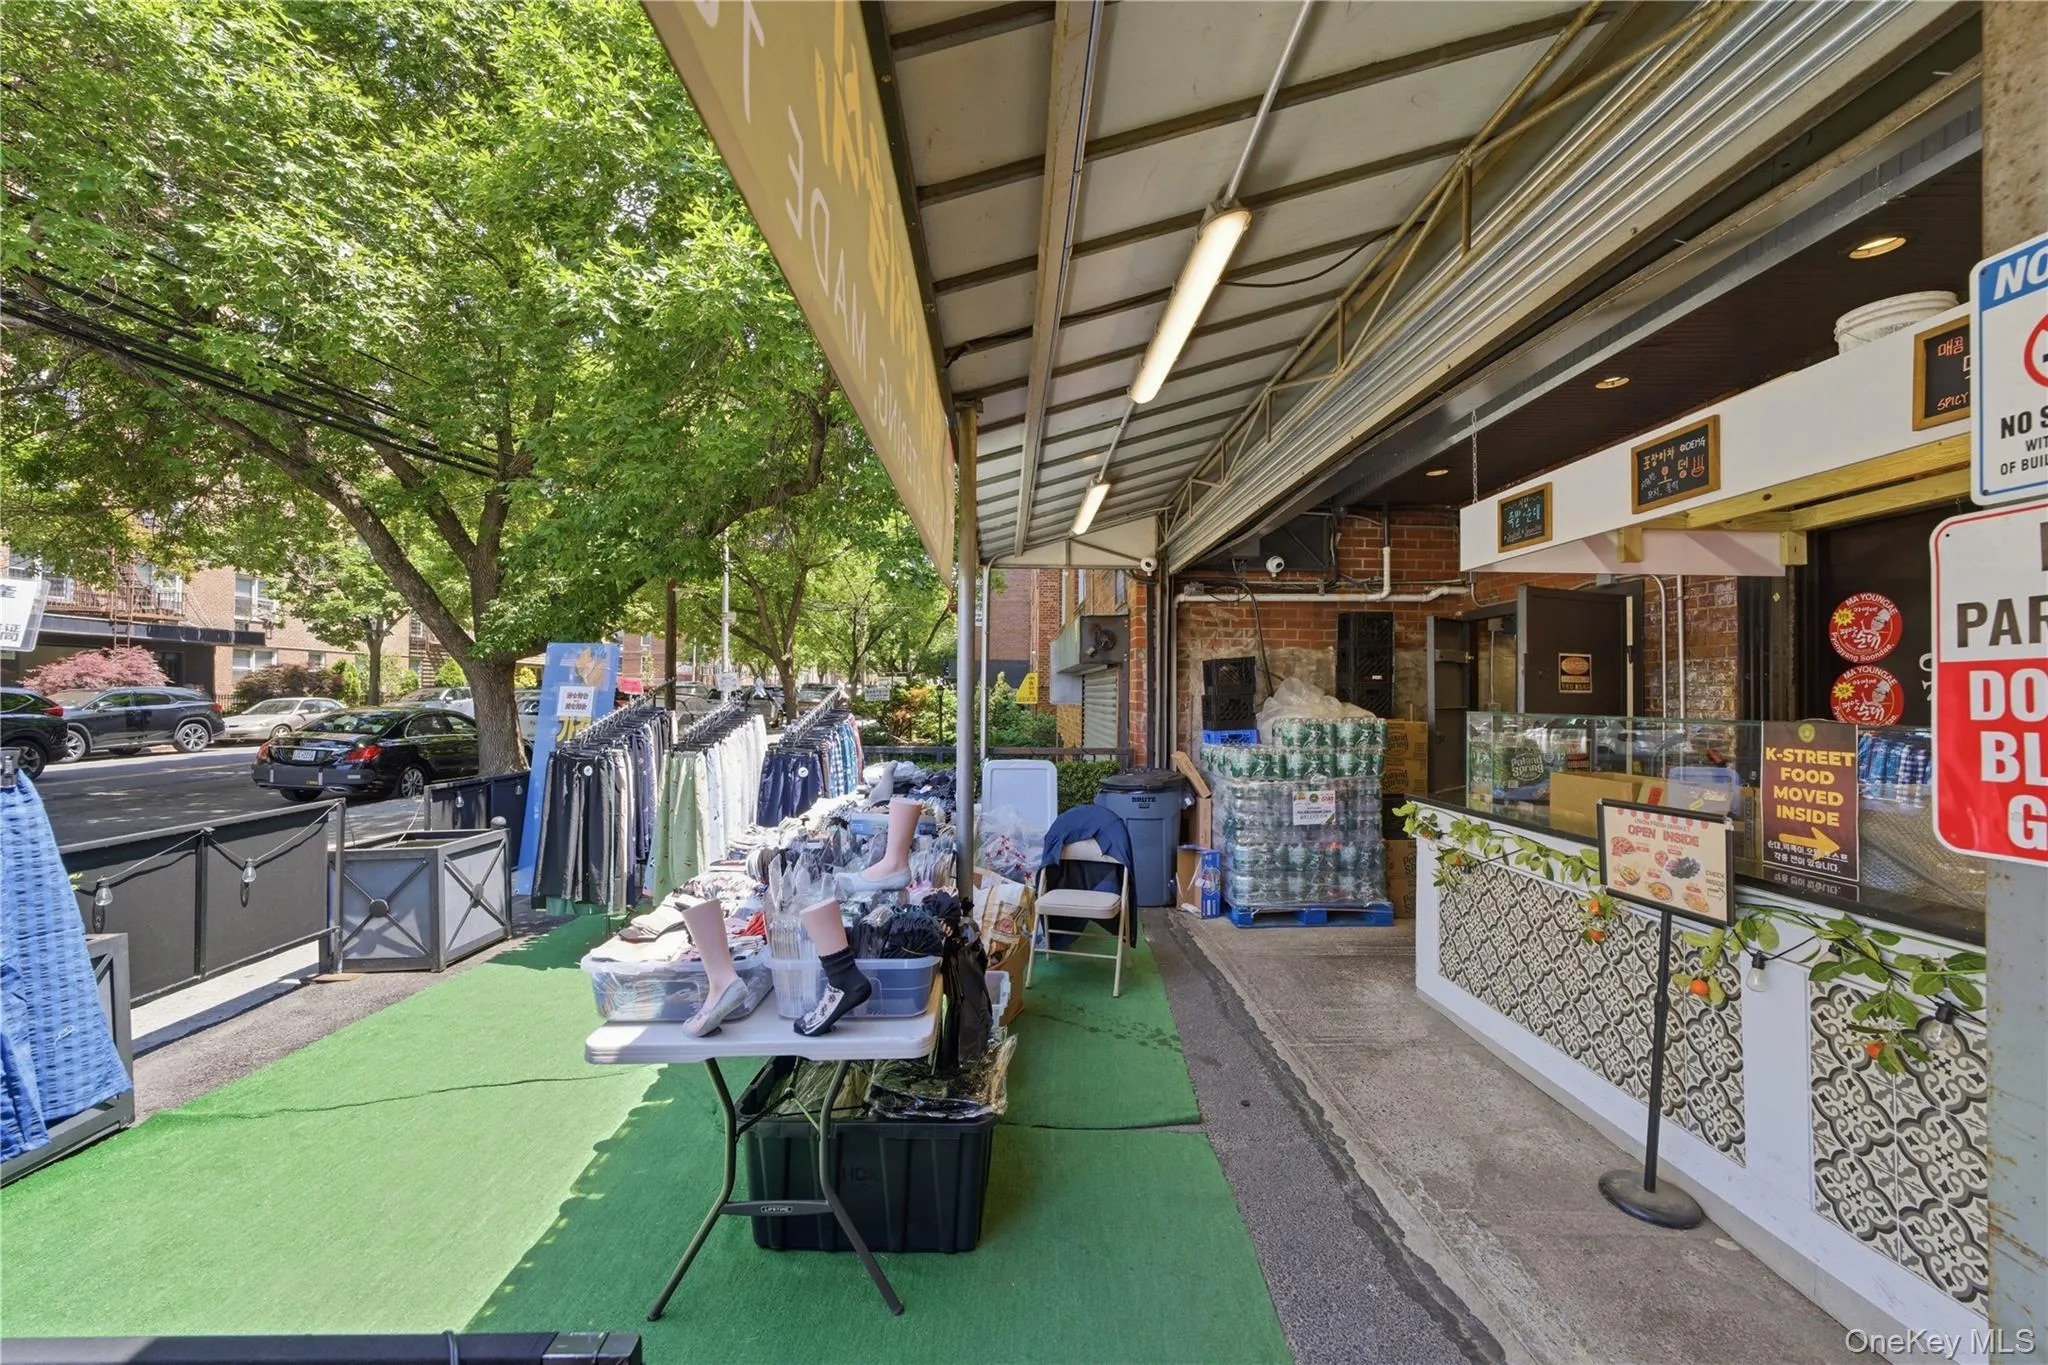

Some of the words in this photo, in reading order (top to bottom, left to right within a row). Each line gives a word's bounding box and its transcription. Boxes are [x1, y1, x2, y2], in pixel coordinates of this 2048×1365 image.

[1938, 336, 1964, 357] 매콤
[1937, 391, 1968, 411] SPICY
[2001, 410, 2032, 440] NO
[2000, 461, 2016, 476] OF
[1845, 595, 1859, 606] MA
[1860, 593, 1898, 616] YOUNGAE
[1843, 668, 1856, 680] MA
[1857, 665, 1898, 687] YOUNGAE
[1511, 755, 1543, 767] Poland
[1765, 747, 1855, 767] K-STREET
[1512, 763, 1544, 777] Spring
[1780, 767, 1835, 785] FOOD
[1773, 785, 1844, 807] MOVED
[1776, 804, 1840, 827] INSIDE
[1627, 824, 1656, 839] OPEN
[1663, 830, 1699, 848] INSIDE
